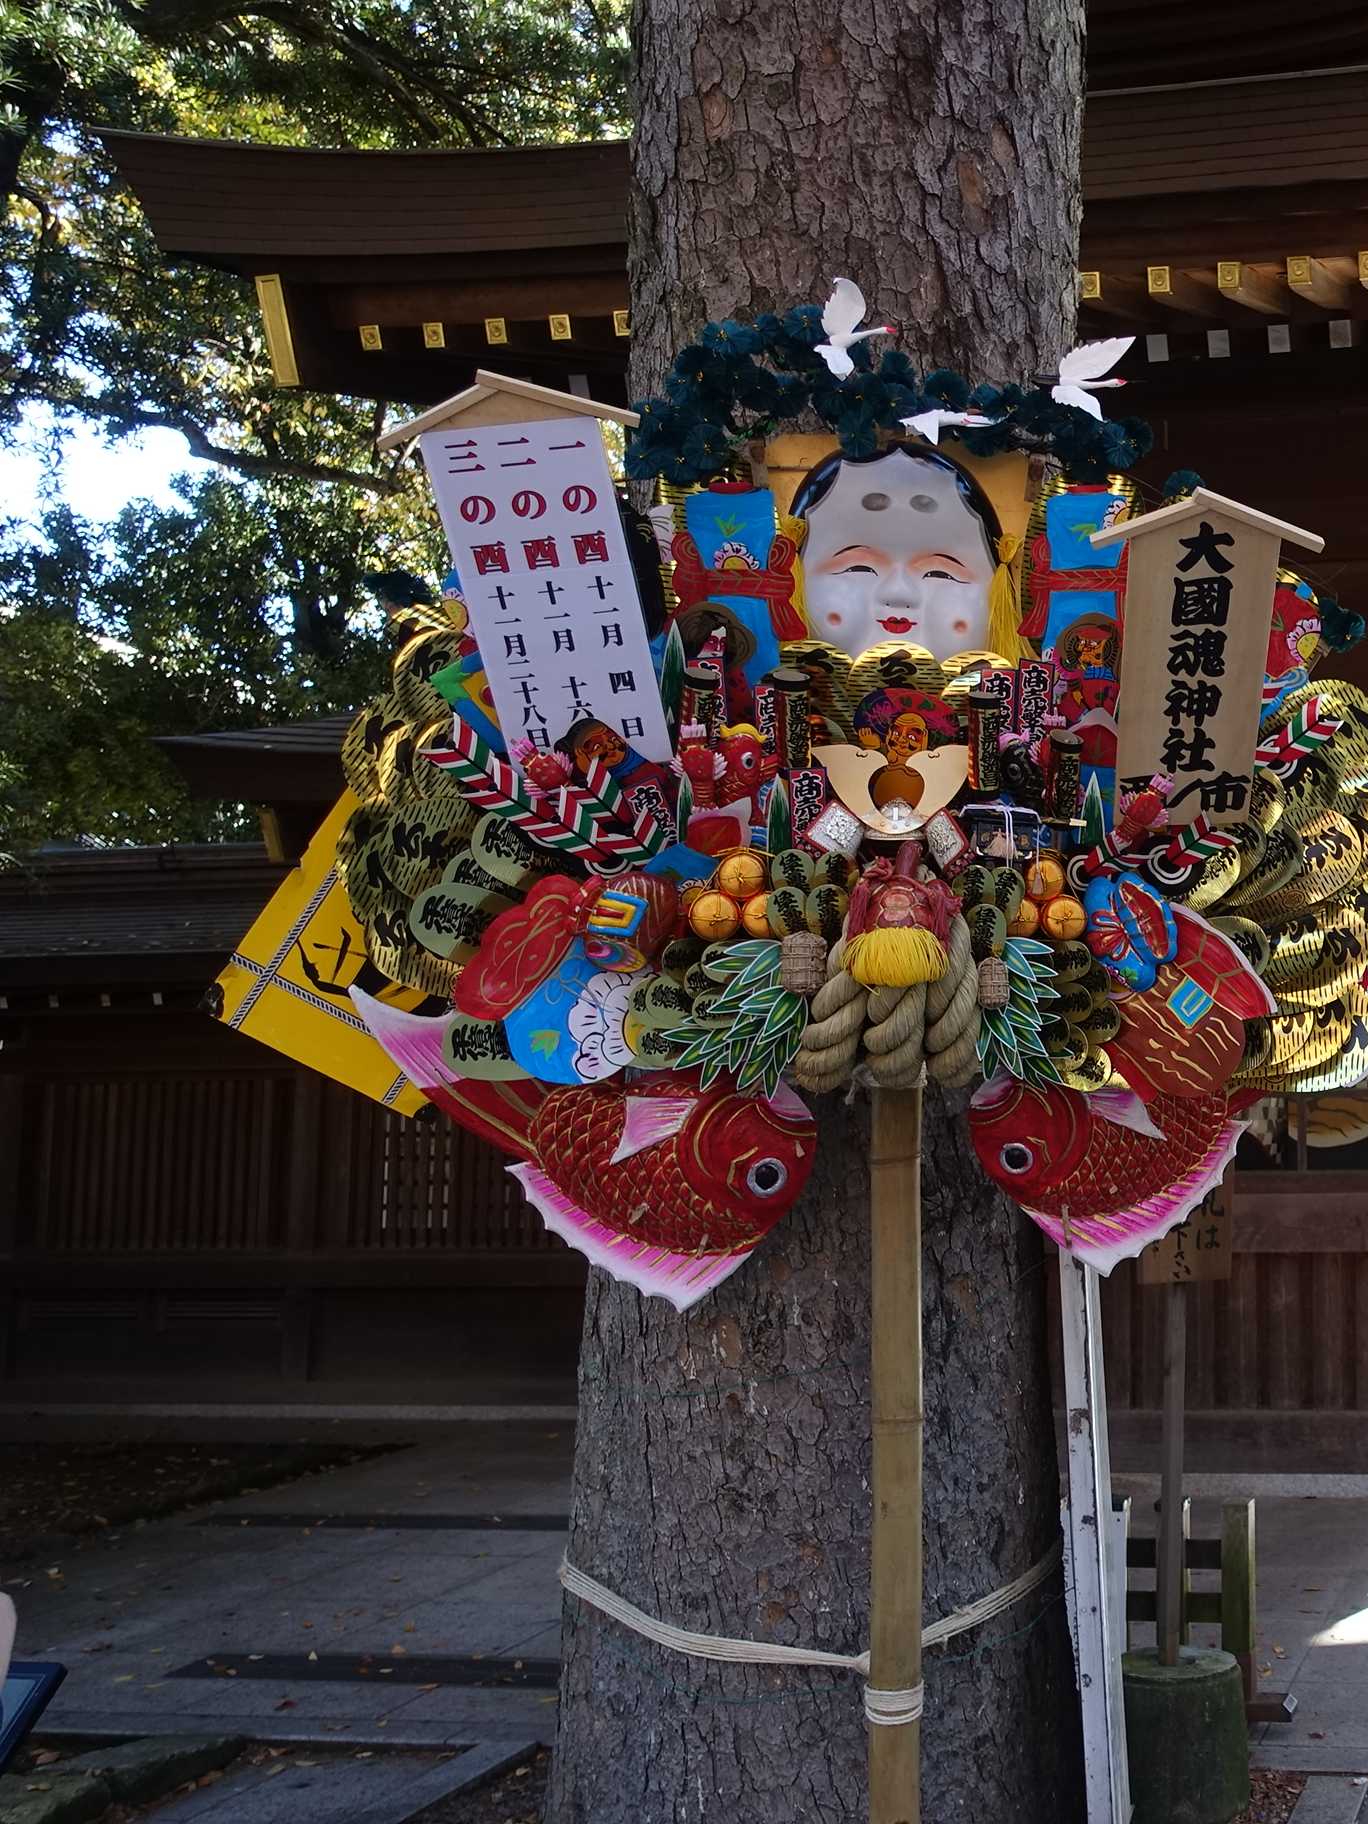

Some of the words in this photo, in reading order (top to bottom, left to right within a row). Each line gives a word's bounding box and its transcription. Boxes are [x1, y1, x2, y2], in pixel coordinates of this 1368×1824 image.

[497, 437, 596, 722] 二の酉十一月十六
[1159, 520, 1235, 773] 大國魂神社
